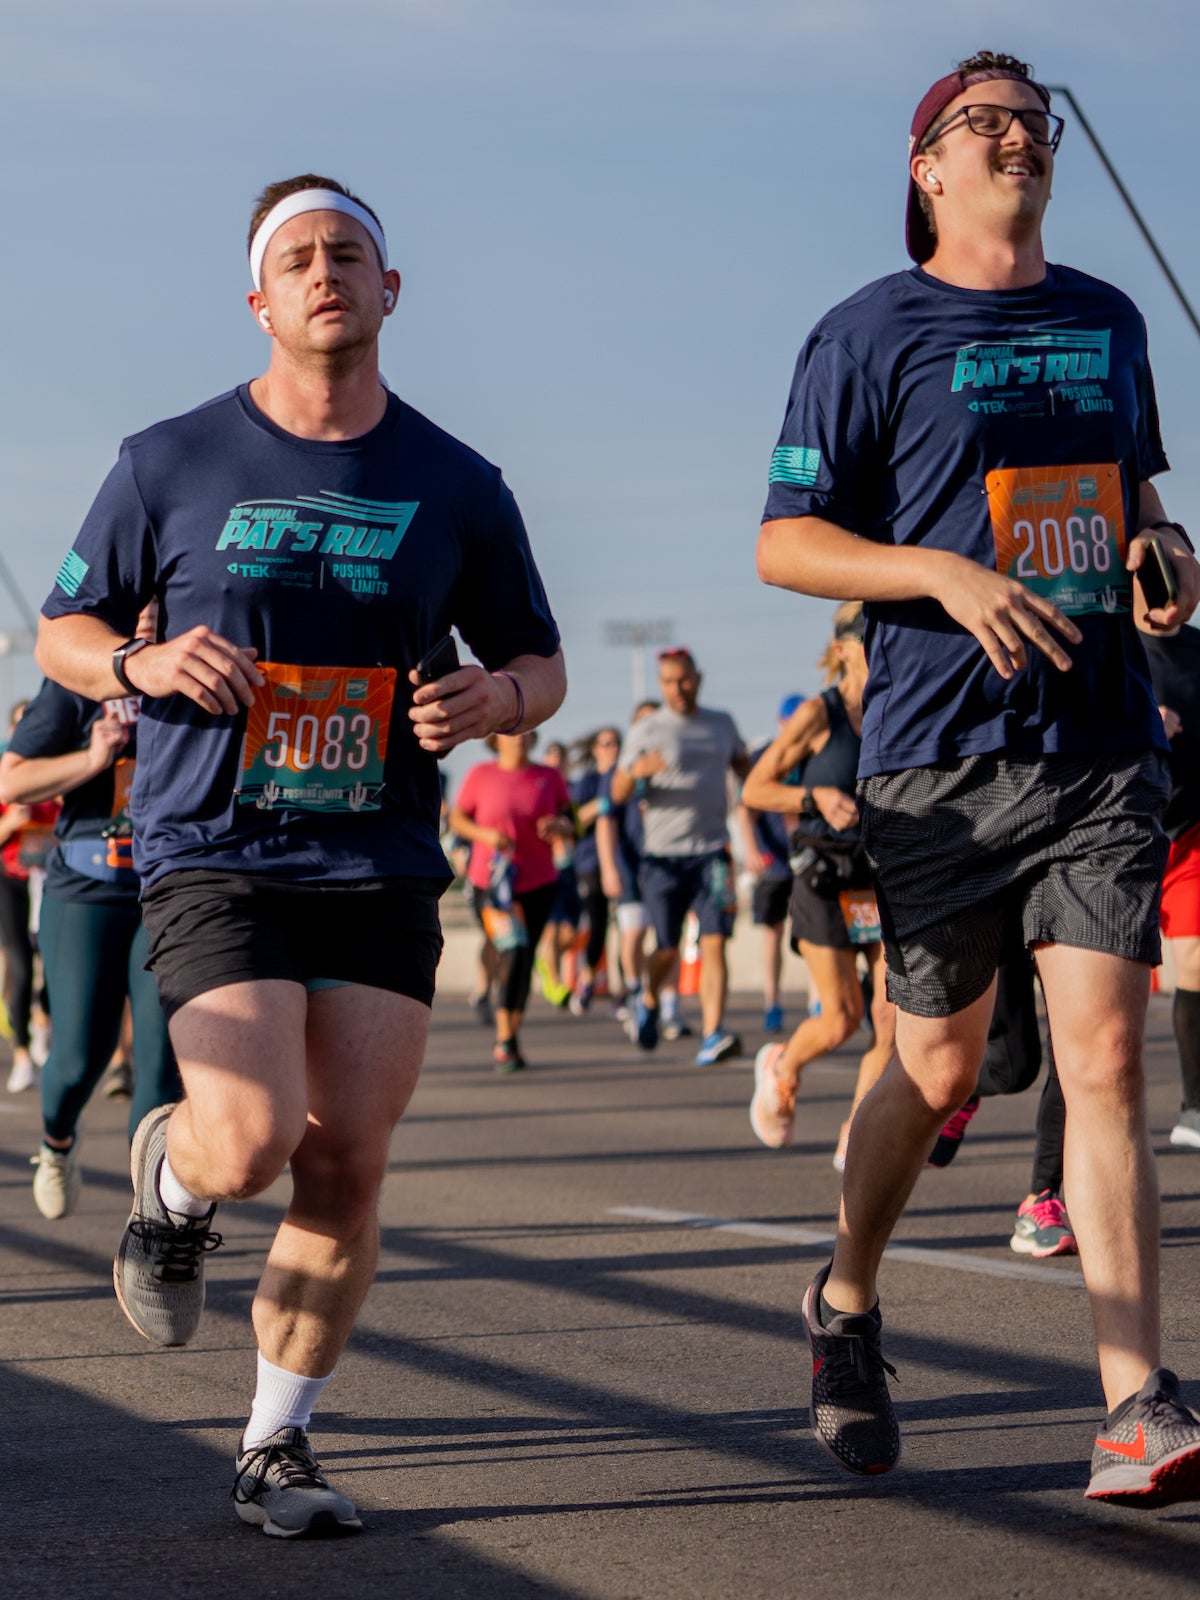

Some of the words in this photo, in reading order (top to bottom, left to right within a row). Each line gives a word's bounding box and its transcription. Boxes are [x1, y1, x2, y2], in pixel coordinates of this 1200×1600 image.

[951, 355, 1041, 392] PAT'S
[1043, 352, 1109, 382] RUN
[1061, 384, 1102, 401] PUSHING
[1080, 398, 1113, 413] LIMITS
[250, 508, 298, 521] ANNUAL
[215, 520, 324, 552] PAT'S
[318, 524, 406, 560] RUN
[1013, 515, 1111, 578] 2068
[332, 563, 380, 579] PUSHING
[351, 579, 389, 596] LIMITS
[263, 711, 372, 771] 5083
